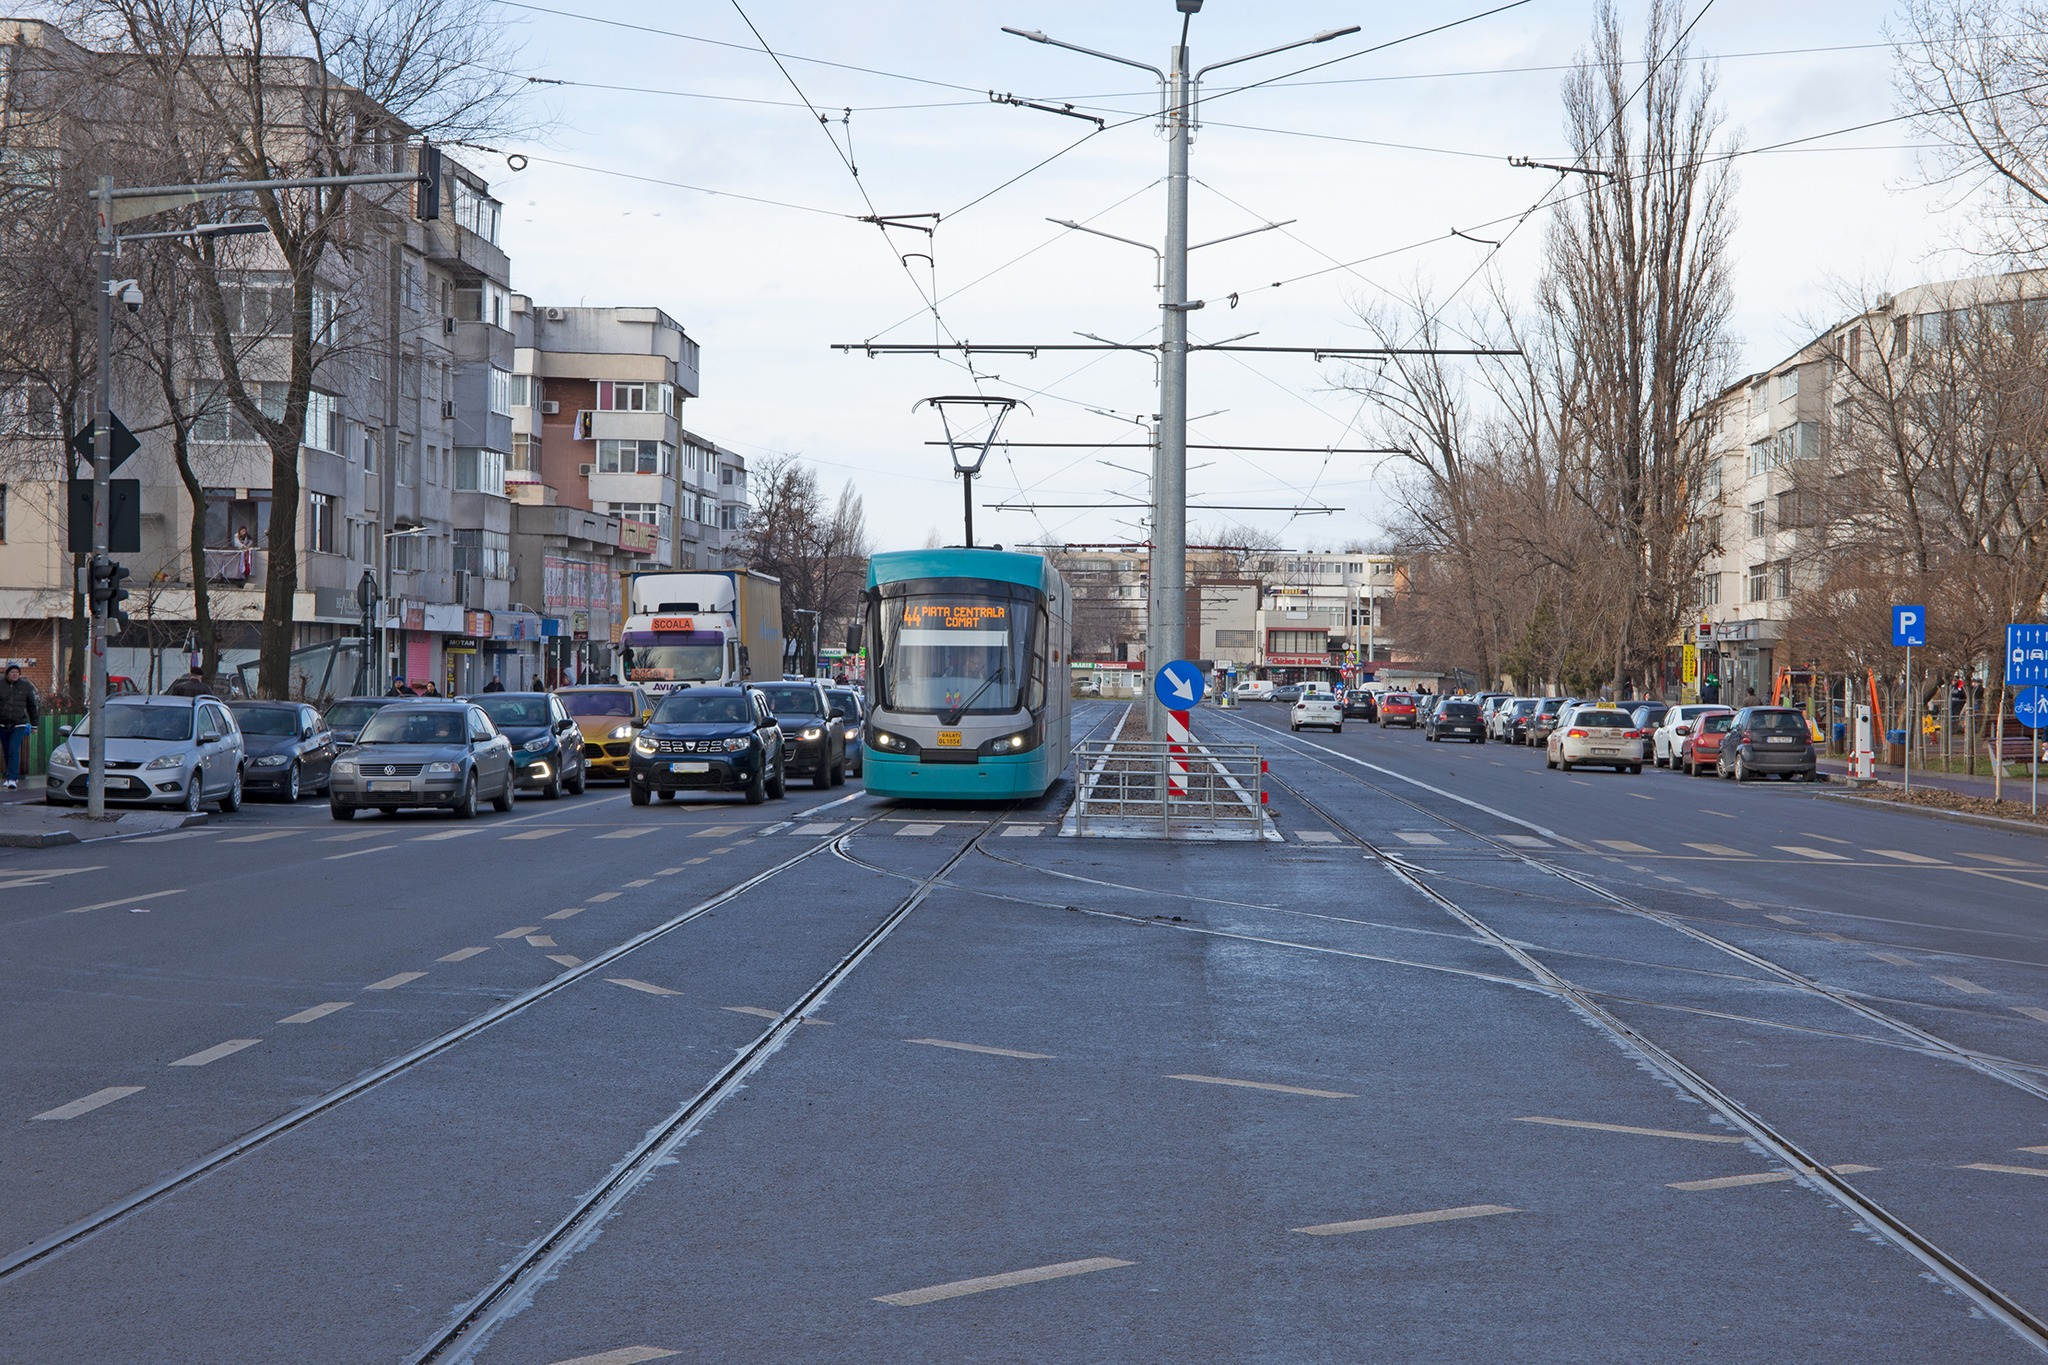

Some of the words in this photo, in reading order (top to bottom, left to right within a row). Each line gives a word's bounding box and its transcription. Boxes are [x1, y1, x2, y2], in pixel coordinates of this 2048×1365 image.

[904, 606, 921, 626] 44
[922, 606, 950, 616] PIATA
[954, 606, 1005, 618] CENTRALA
[654, 620, 690, 629] SCOALA
[945, 616, 980, 628] COMAT
[1900, 612, 1917, 634] P
[1272, 657, 1296, 665] Chicken
[634, 668, 670, 679] SCOALA
